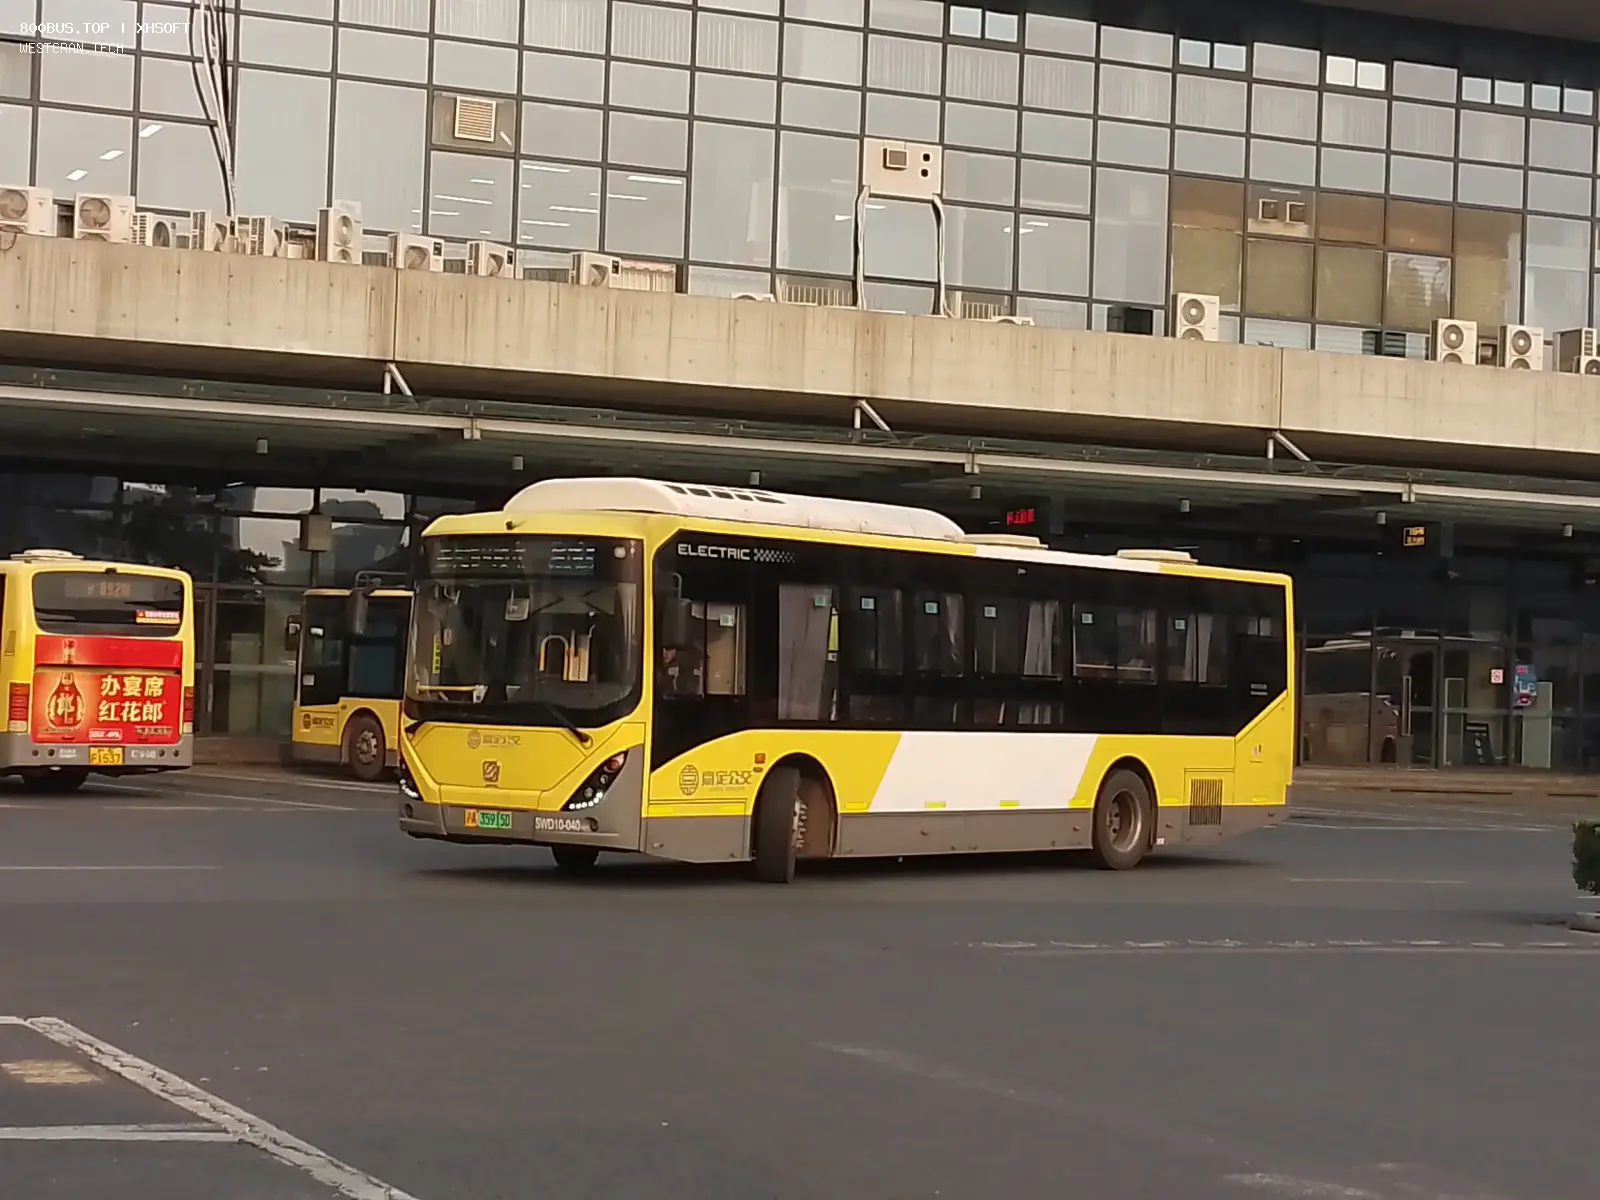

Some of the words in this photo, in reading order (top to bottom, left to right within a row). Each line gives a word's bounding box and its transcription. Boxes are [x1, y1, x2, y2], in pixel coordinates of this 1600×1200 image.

[677, 543, 751, 560] ELECTRIC
[100, 675, 165, 697] 办宴席
[98, 700, 164, 723] 红花郎
[535, 816, 581, 831] SWD10-040
